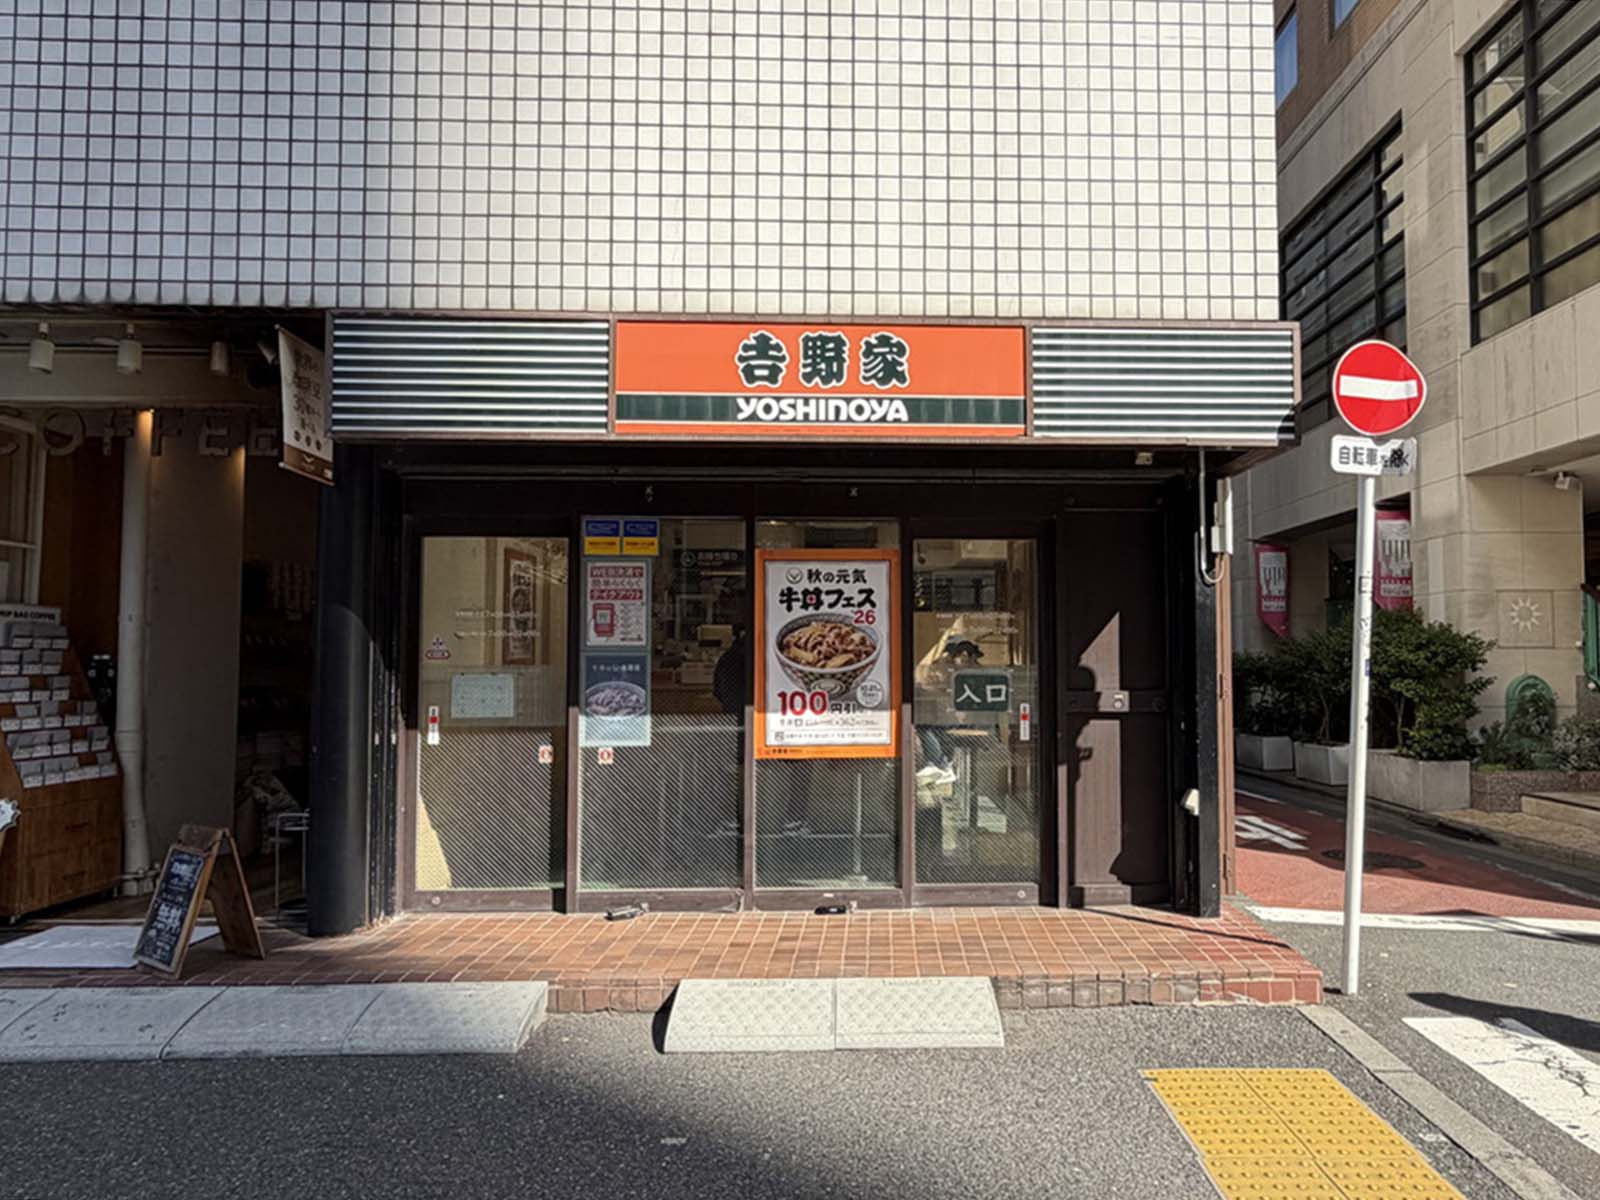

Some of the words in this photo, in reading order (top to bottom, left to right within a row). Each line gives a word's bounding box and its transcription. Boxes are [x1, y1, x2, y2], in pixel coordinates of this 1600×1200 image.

[735, 330, 909, 389] 吉野家
[736, 397, 909, 421] YOSHINOYA
[0, 405, 280, 457] OFFEE
[807, 568, 867, 584] 秋の元気
[779, 586, 876, 612] 牛丼フェス
[955, 684, 1006, 703] 入口
